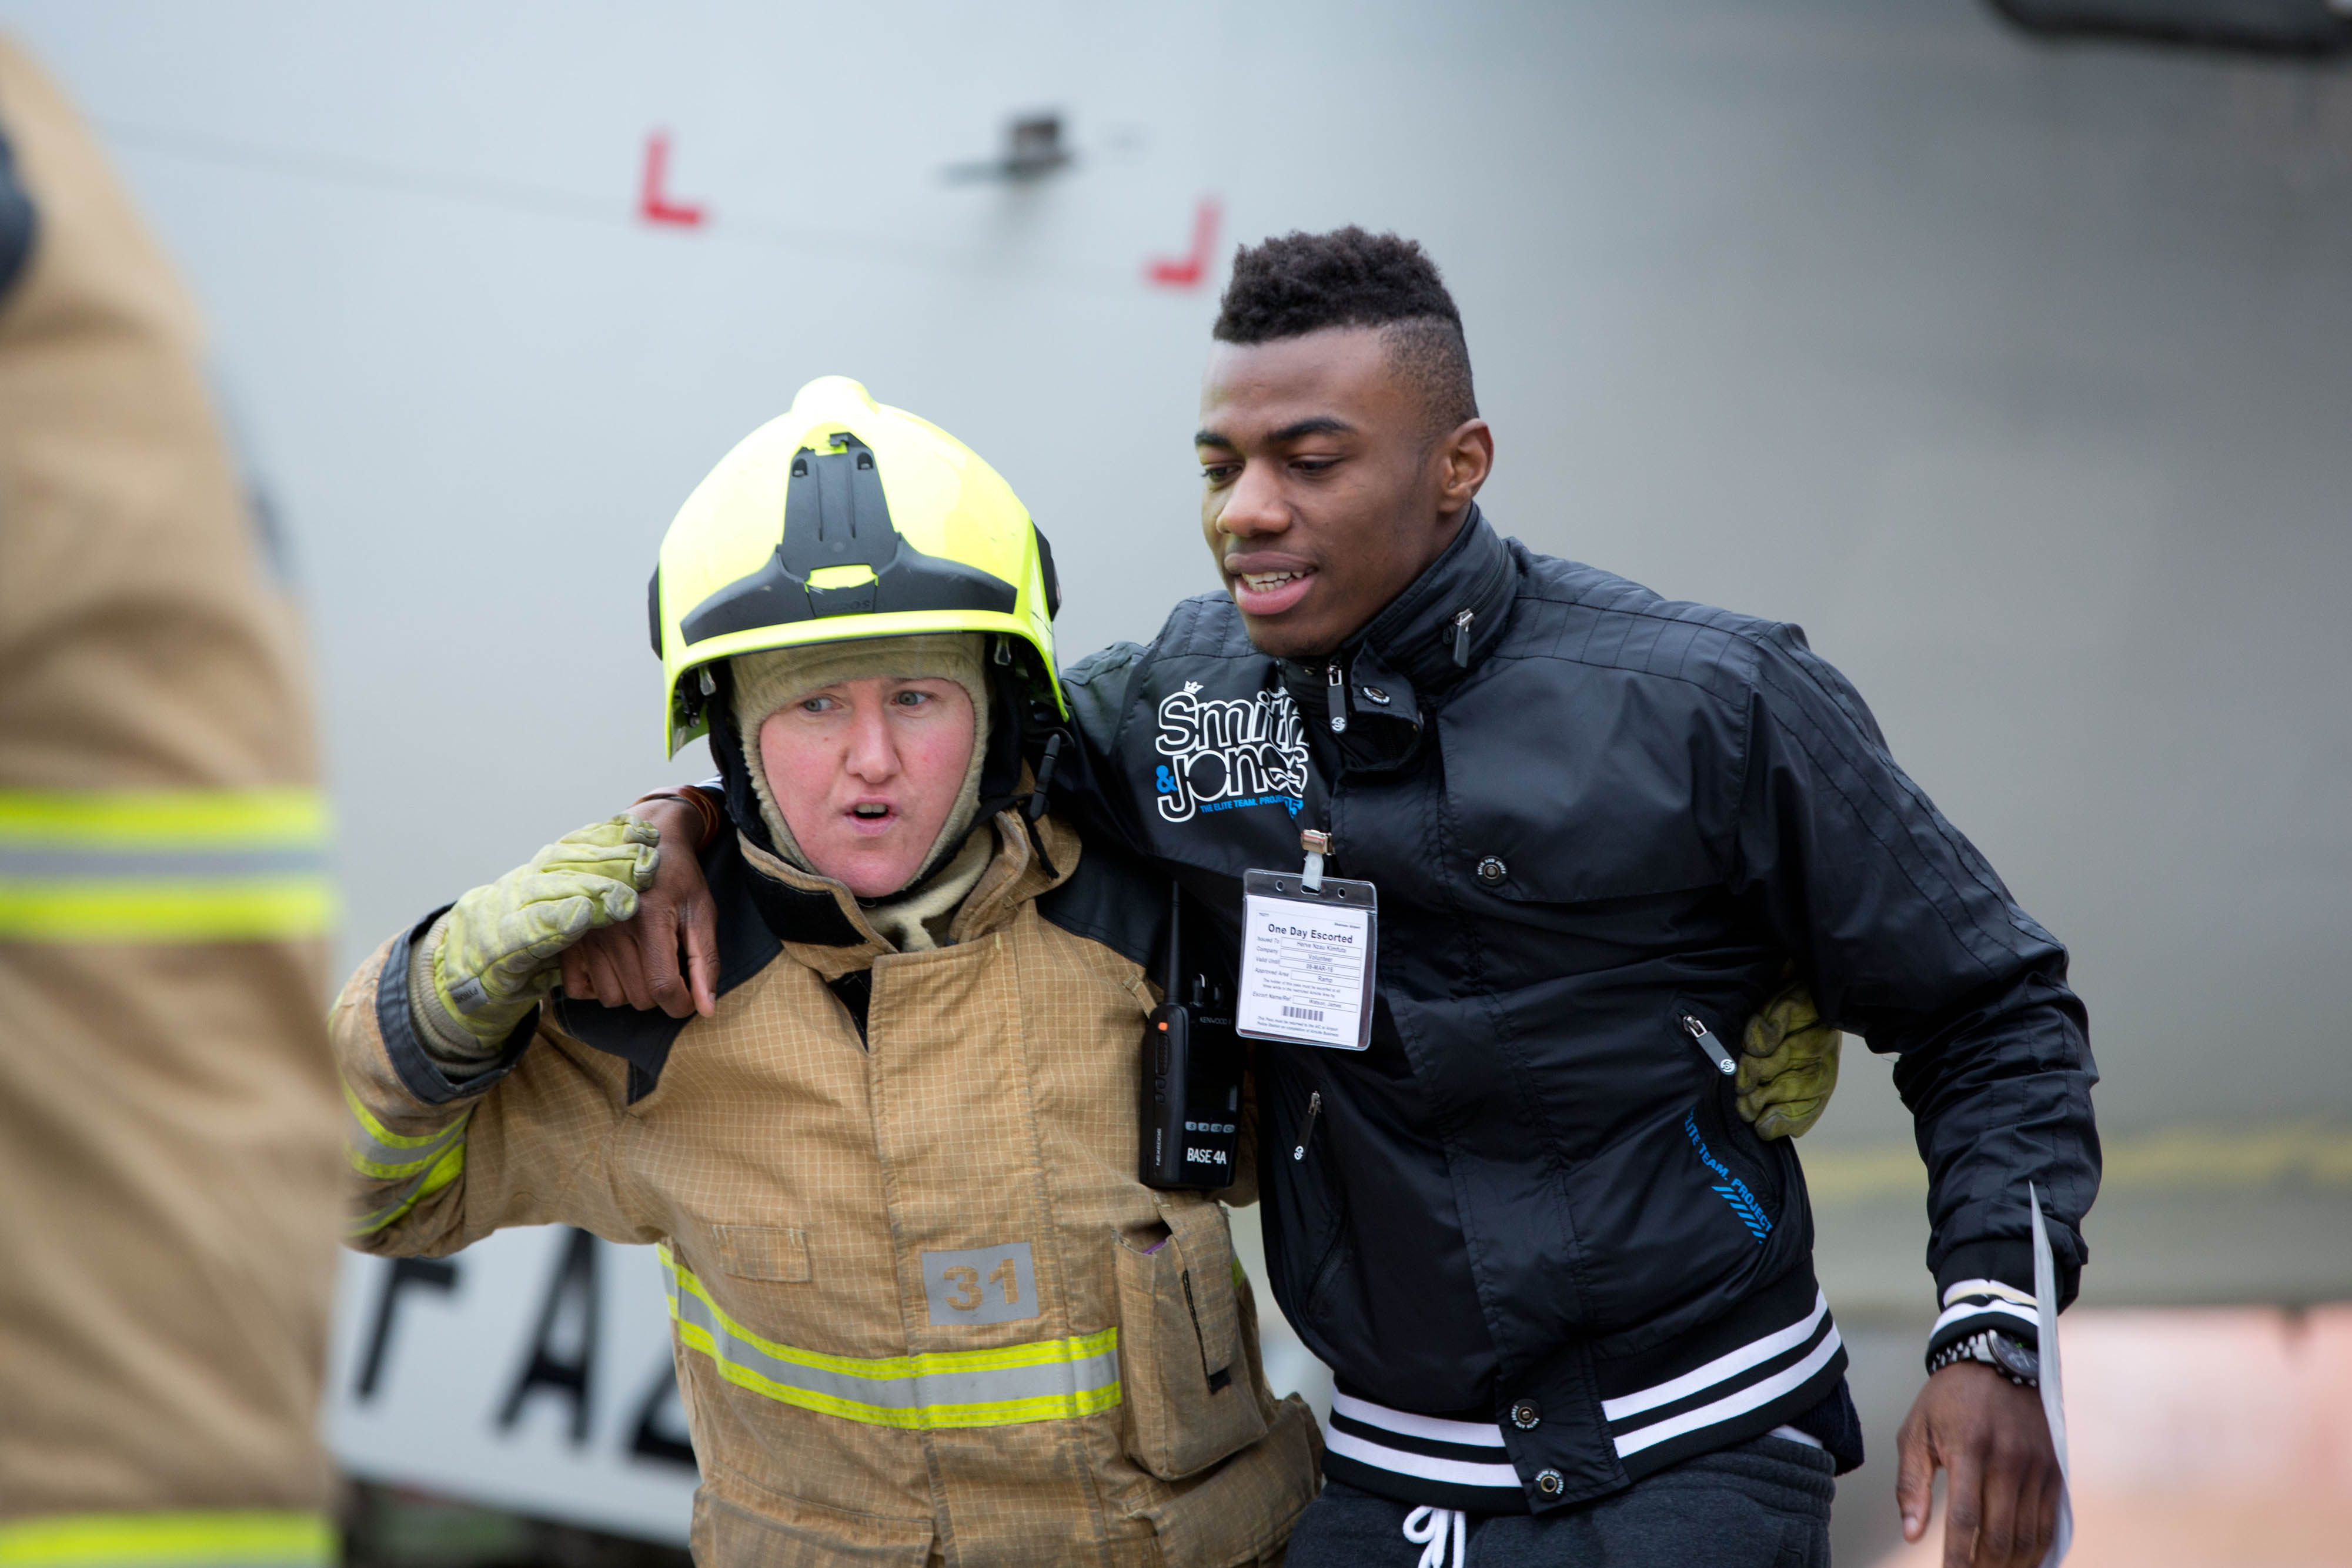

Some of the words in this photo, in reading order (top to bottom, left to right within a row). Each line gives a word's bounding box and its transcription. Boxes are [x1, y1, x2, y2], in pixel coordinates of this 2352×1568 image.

[1155, 765, 1178, 793] &
[1200, 804, 1214, 813] THE
[1214, 800, 1233, 811] ELITE
[1233, 798, 1258, 808] TEAM.
[1268, 924, 1287, 935] One
[1291, 927, 1307, 939] Day
[1311, 930, 1352, 944] Escorted
[1256, 946, 1278, 954] Company
[1187, 1147, 1213, 1164] BASE
[1213, 1150, 1227, 1165] 4A
[1699, 1144, 1729, 1181] TEAM.
[1731, 1178, 1773, 1232] PROJECT
[943, 1258, 1019, 1311] 31
